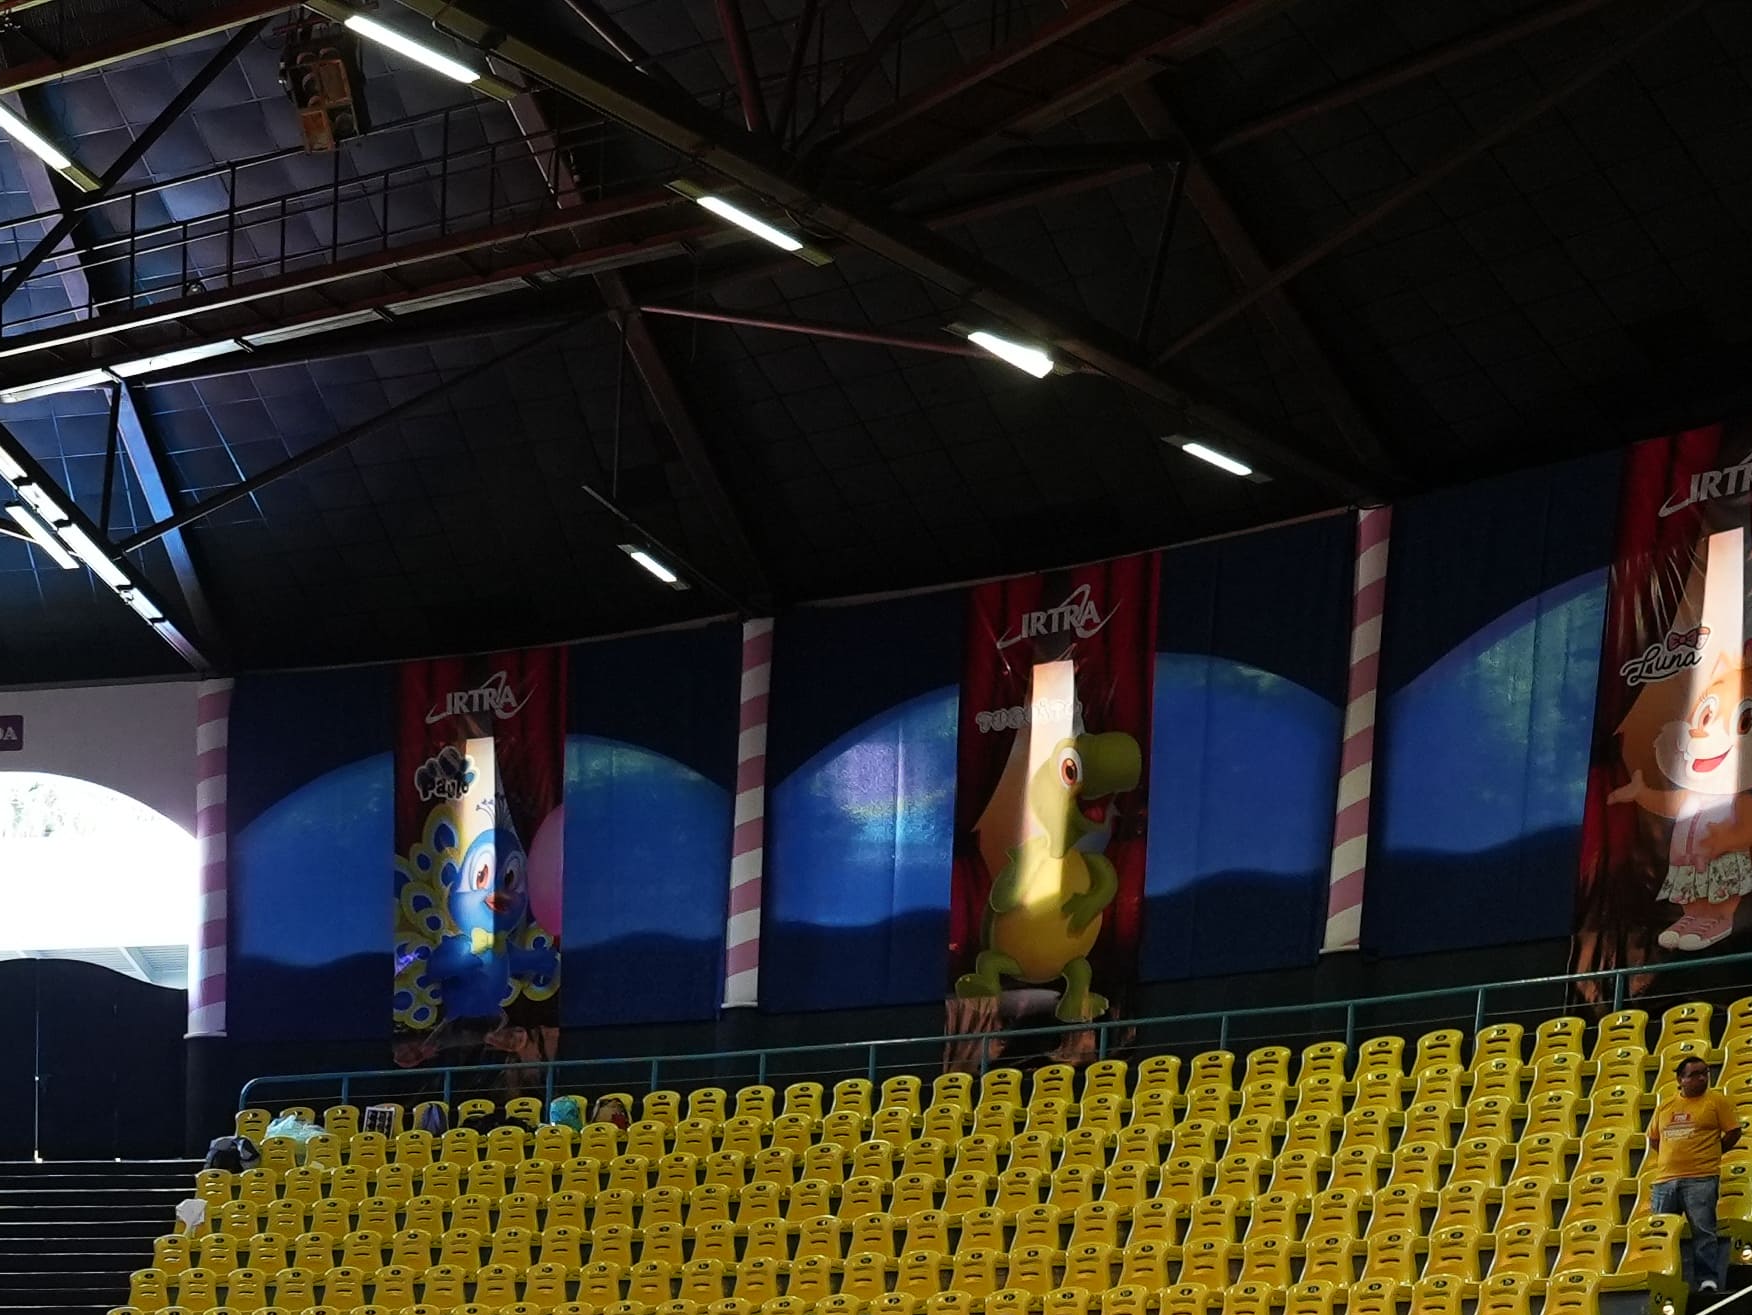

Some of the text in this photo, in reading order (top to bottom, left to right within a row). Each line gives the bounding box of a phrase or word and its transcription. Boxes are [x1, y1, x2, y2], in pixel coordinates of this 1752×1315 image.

[1021, 600, 1101, 639] IRTRA
[1622, 642, 1703, 686] Luna
[446, 685, 518, 715] IRTRA
